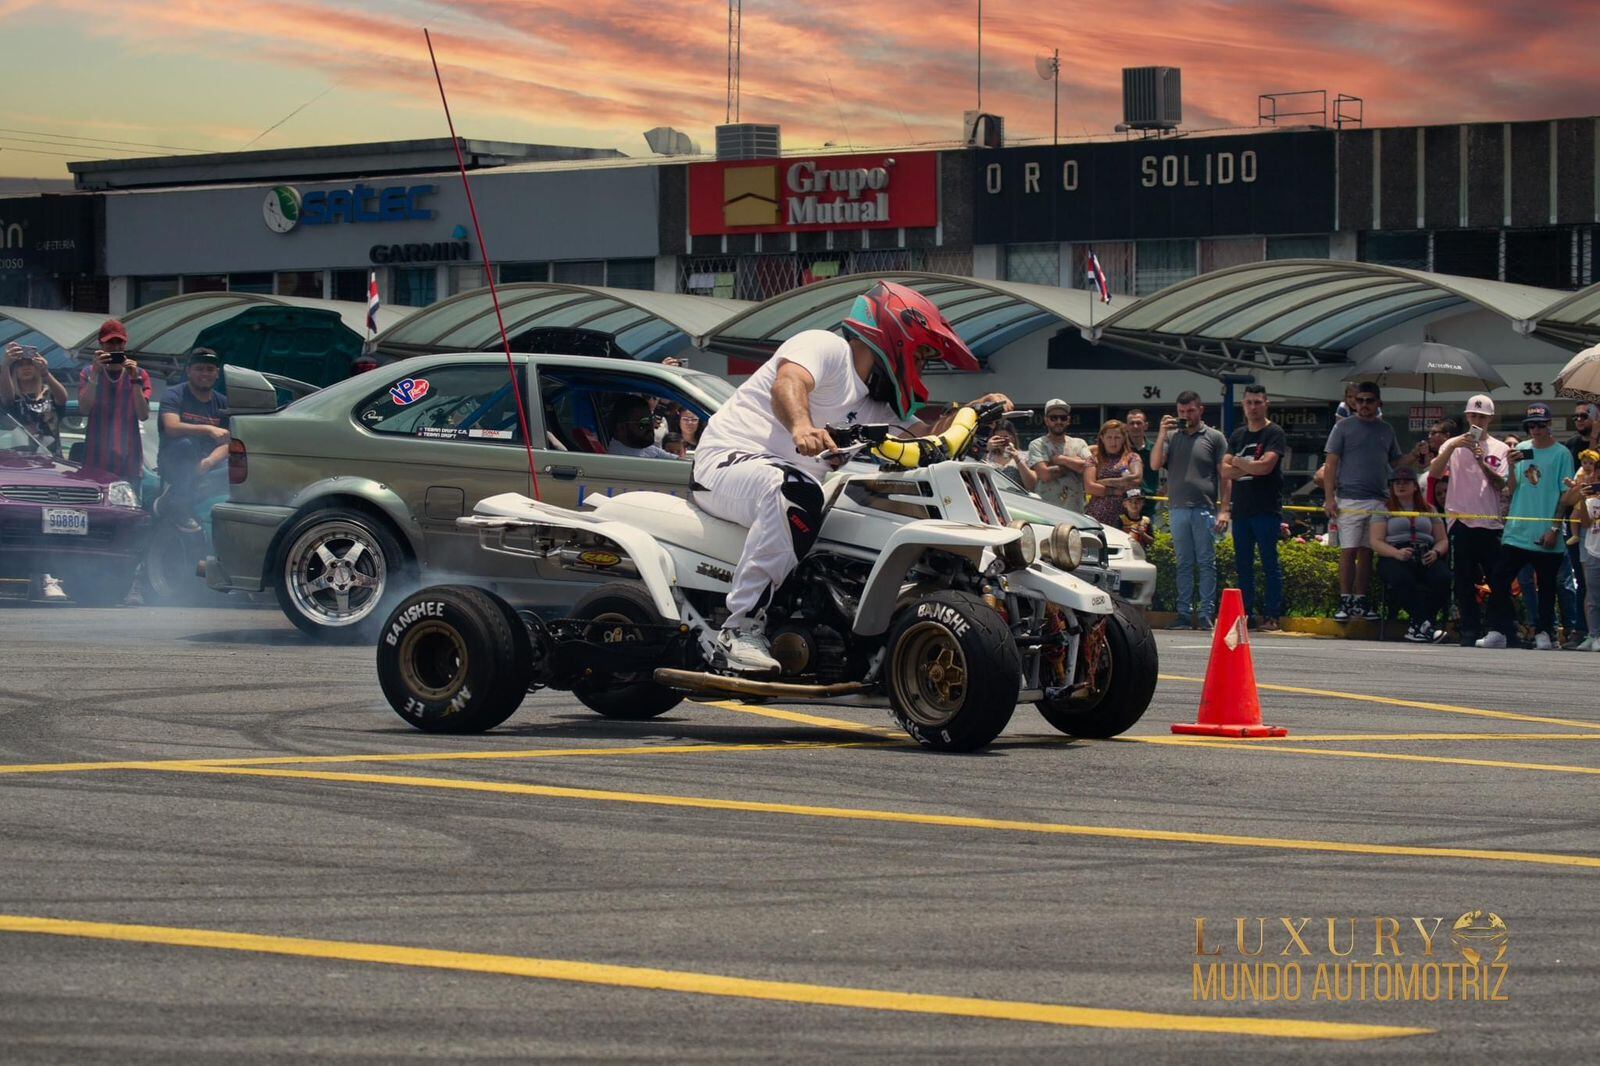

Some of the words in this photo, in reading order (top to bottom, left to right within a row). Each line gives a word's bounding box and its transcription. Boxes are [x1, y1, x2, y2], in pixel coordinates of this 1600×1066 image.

[786, 161, 889, 198] Grupo
[1141, 150, 1258, 188] SOLIDO
[786, 193, 890, 225] Mutual
[369, 241, 471, 263] GARMIN
[389, 378, 415, 404] VP
[1143, 386, 1161, 398] 34
[1523, 382, 1543, 395] 33
[386, 601, 445, 647] BANSHEE
